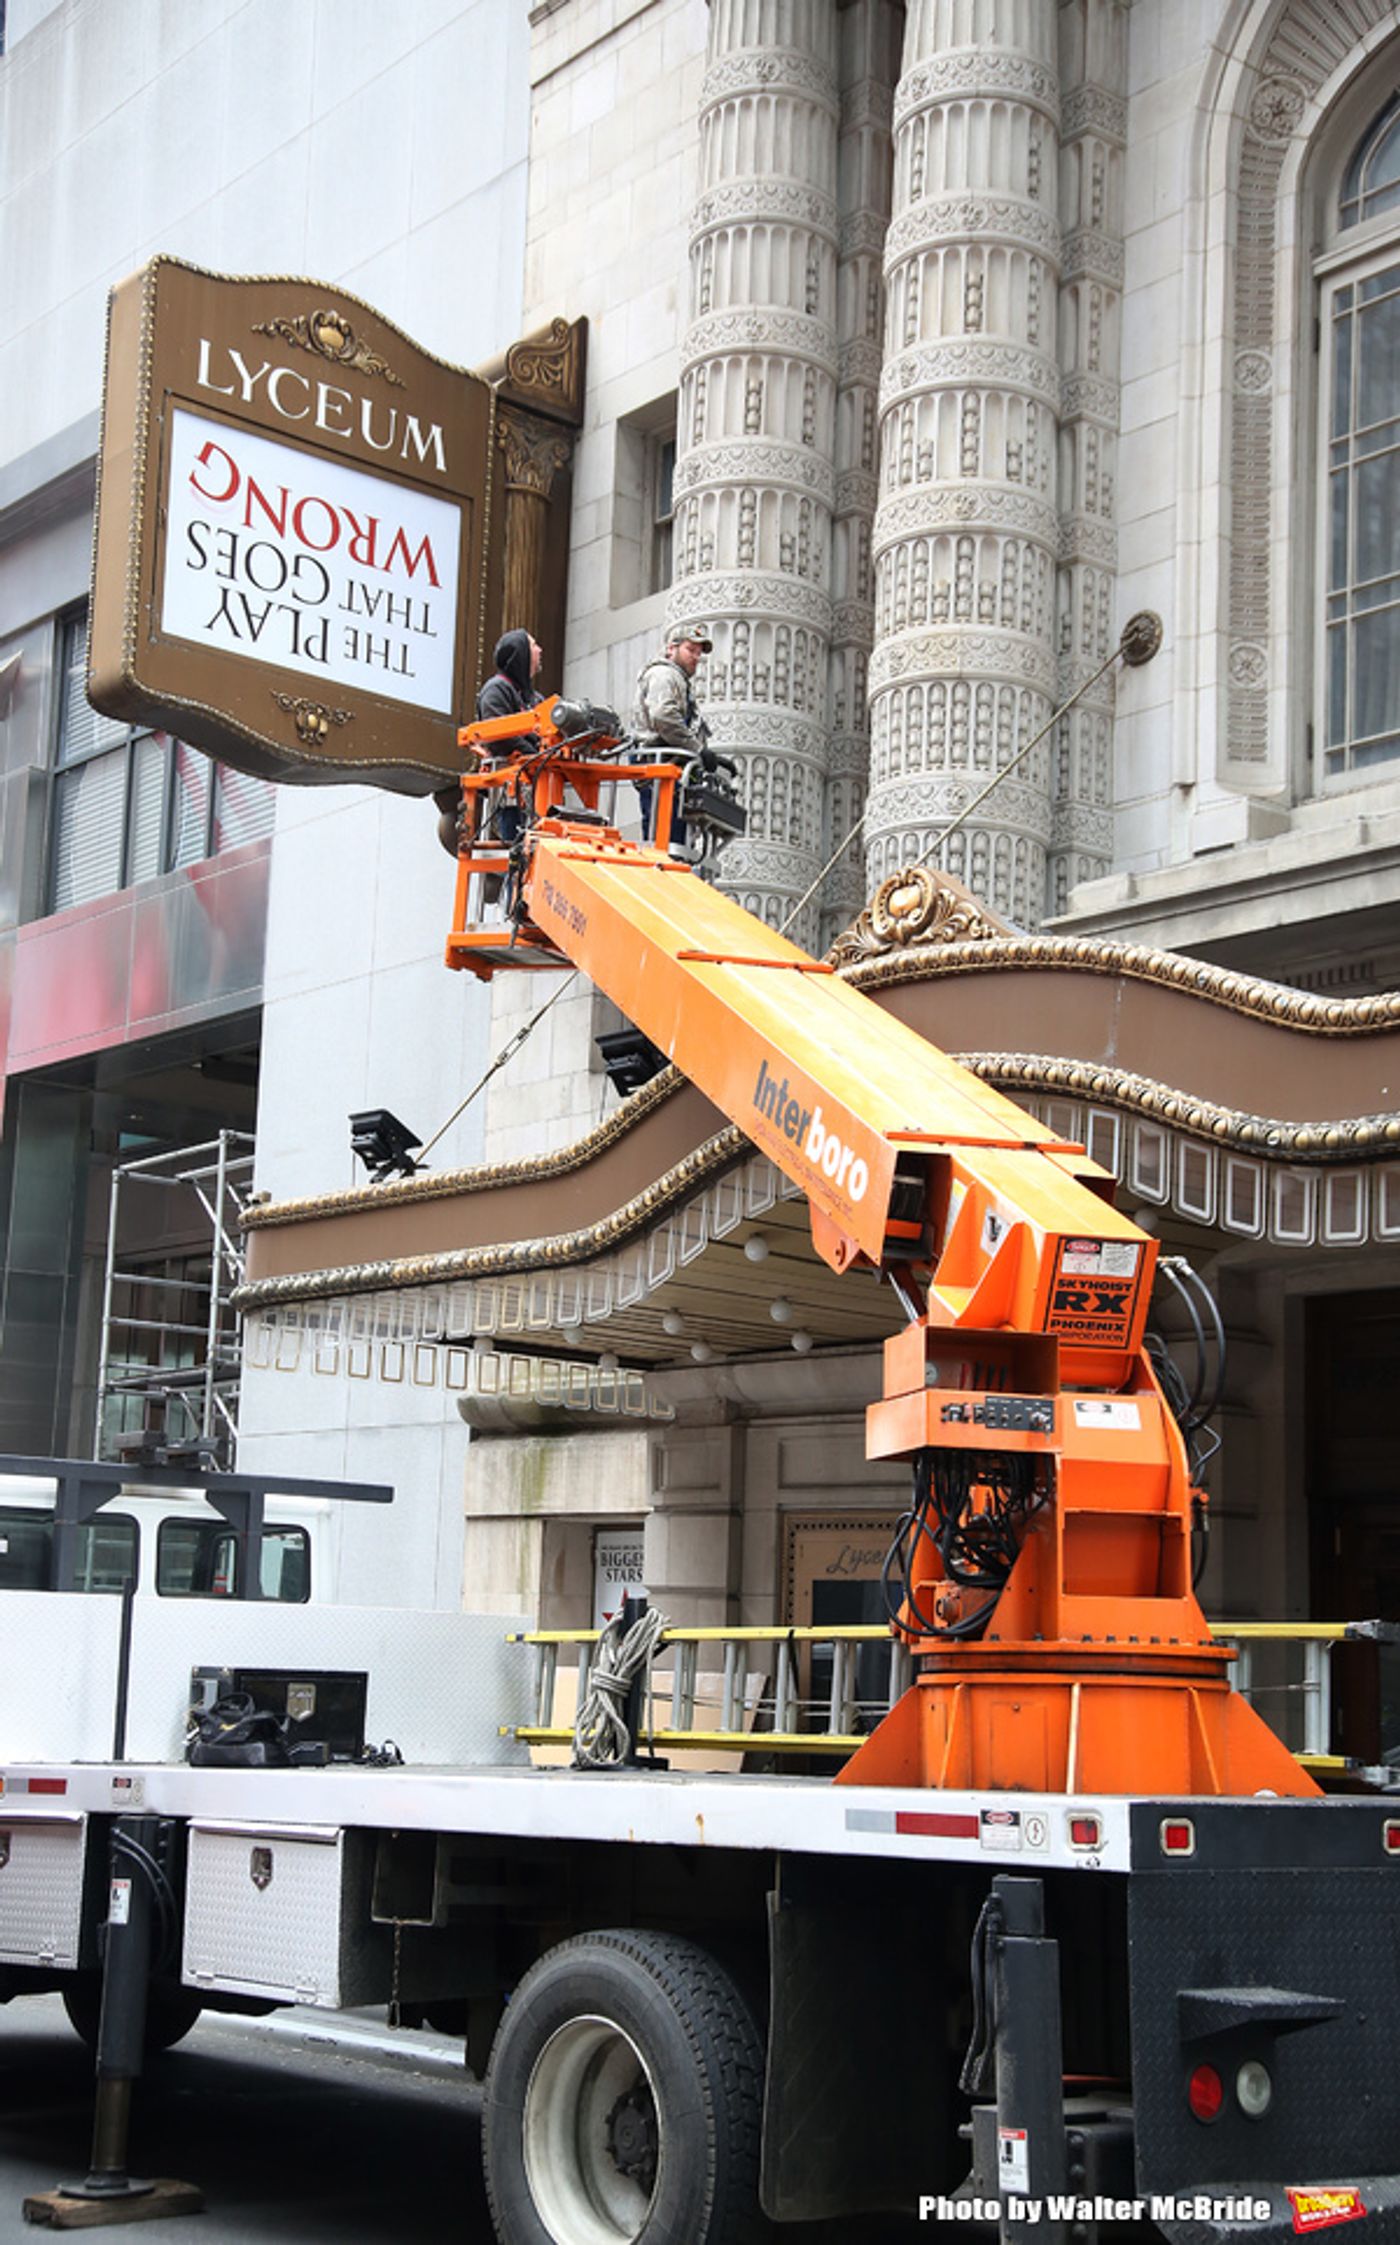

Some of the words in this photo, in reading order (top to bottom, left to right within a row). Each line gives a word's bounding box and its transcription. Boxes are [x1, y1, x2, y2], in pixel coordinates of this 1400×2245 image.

[197, 338, 448, 472] LYCEUM
[189, 440, 442, 588] WRONG
[186, 520, 331, 605] GOES
[203, 586, 331, 665] PLAY
[338, 579, 438, 637] THAT
[344, 628, 415, 677] THE
[753, 1059, 869, 1203] Interboro
[1053, 1291, 1130, 1314] RX
[1058, 1279, 1134, 1292] SKYHOIST
[1050, 1319, 1125, 1332] PHOENIX
[605, 1567, 643, 1584] STARS
